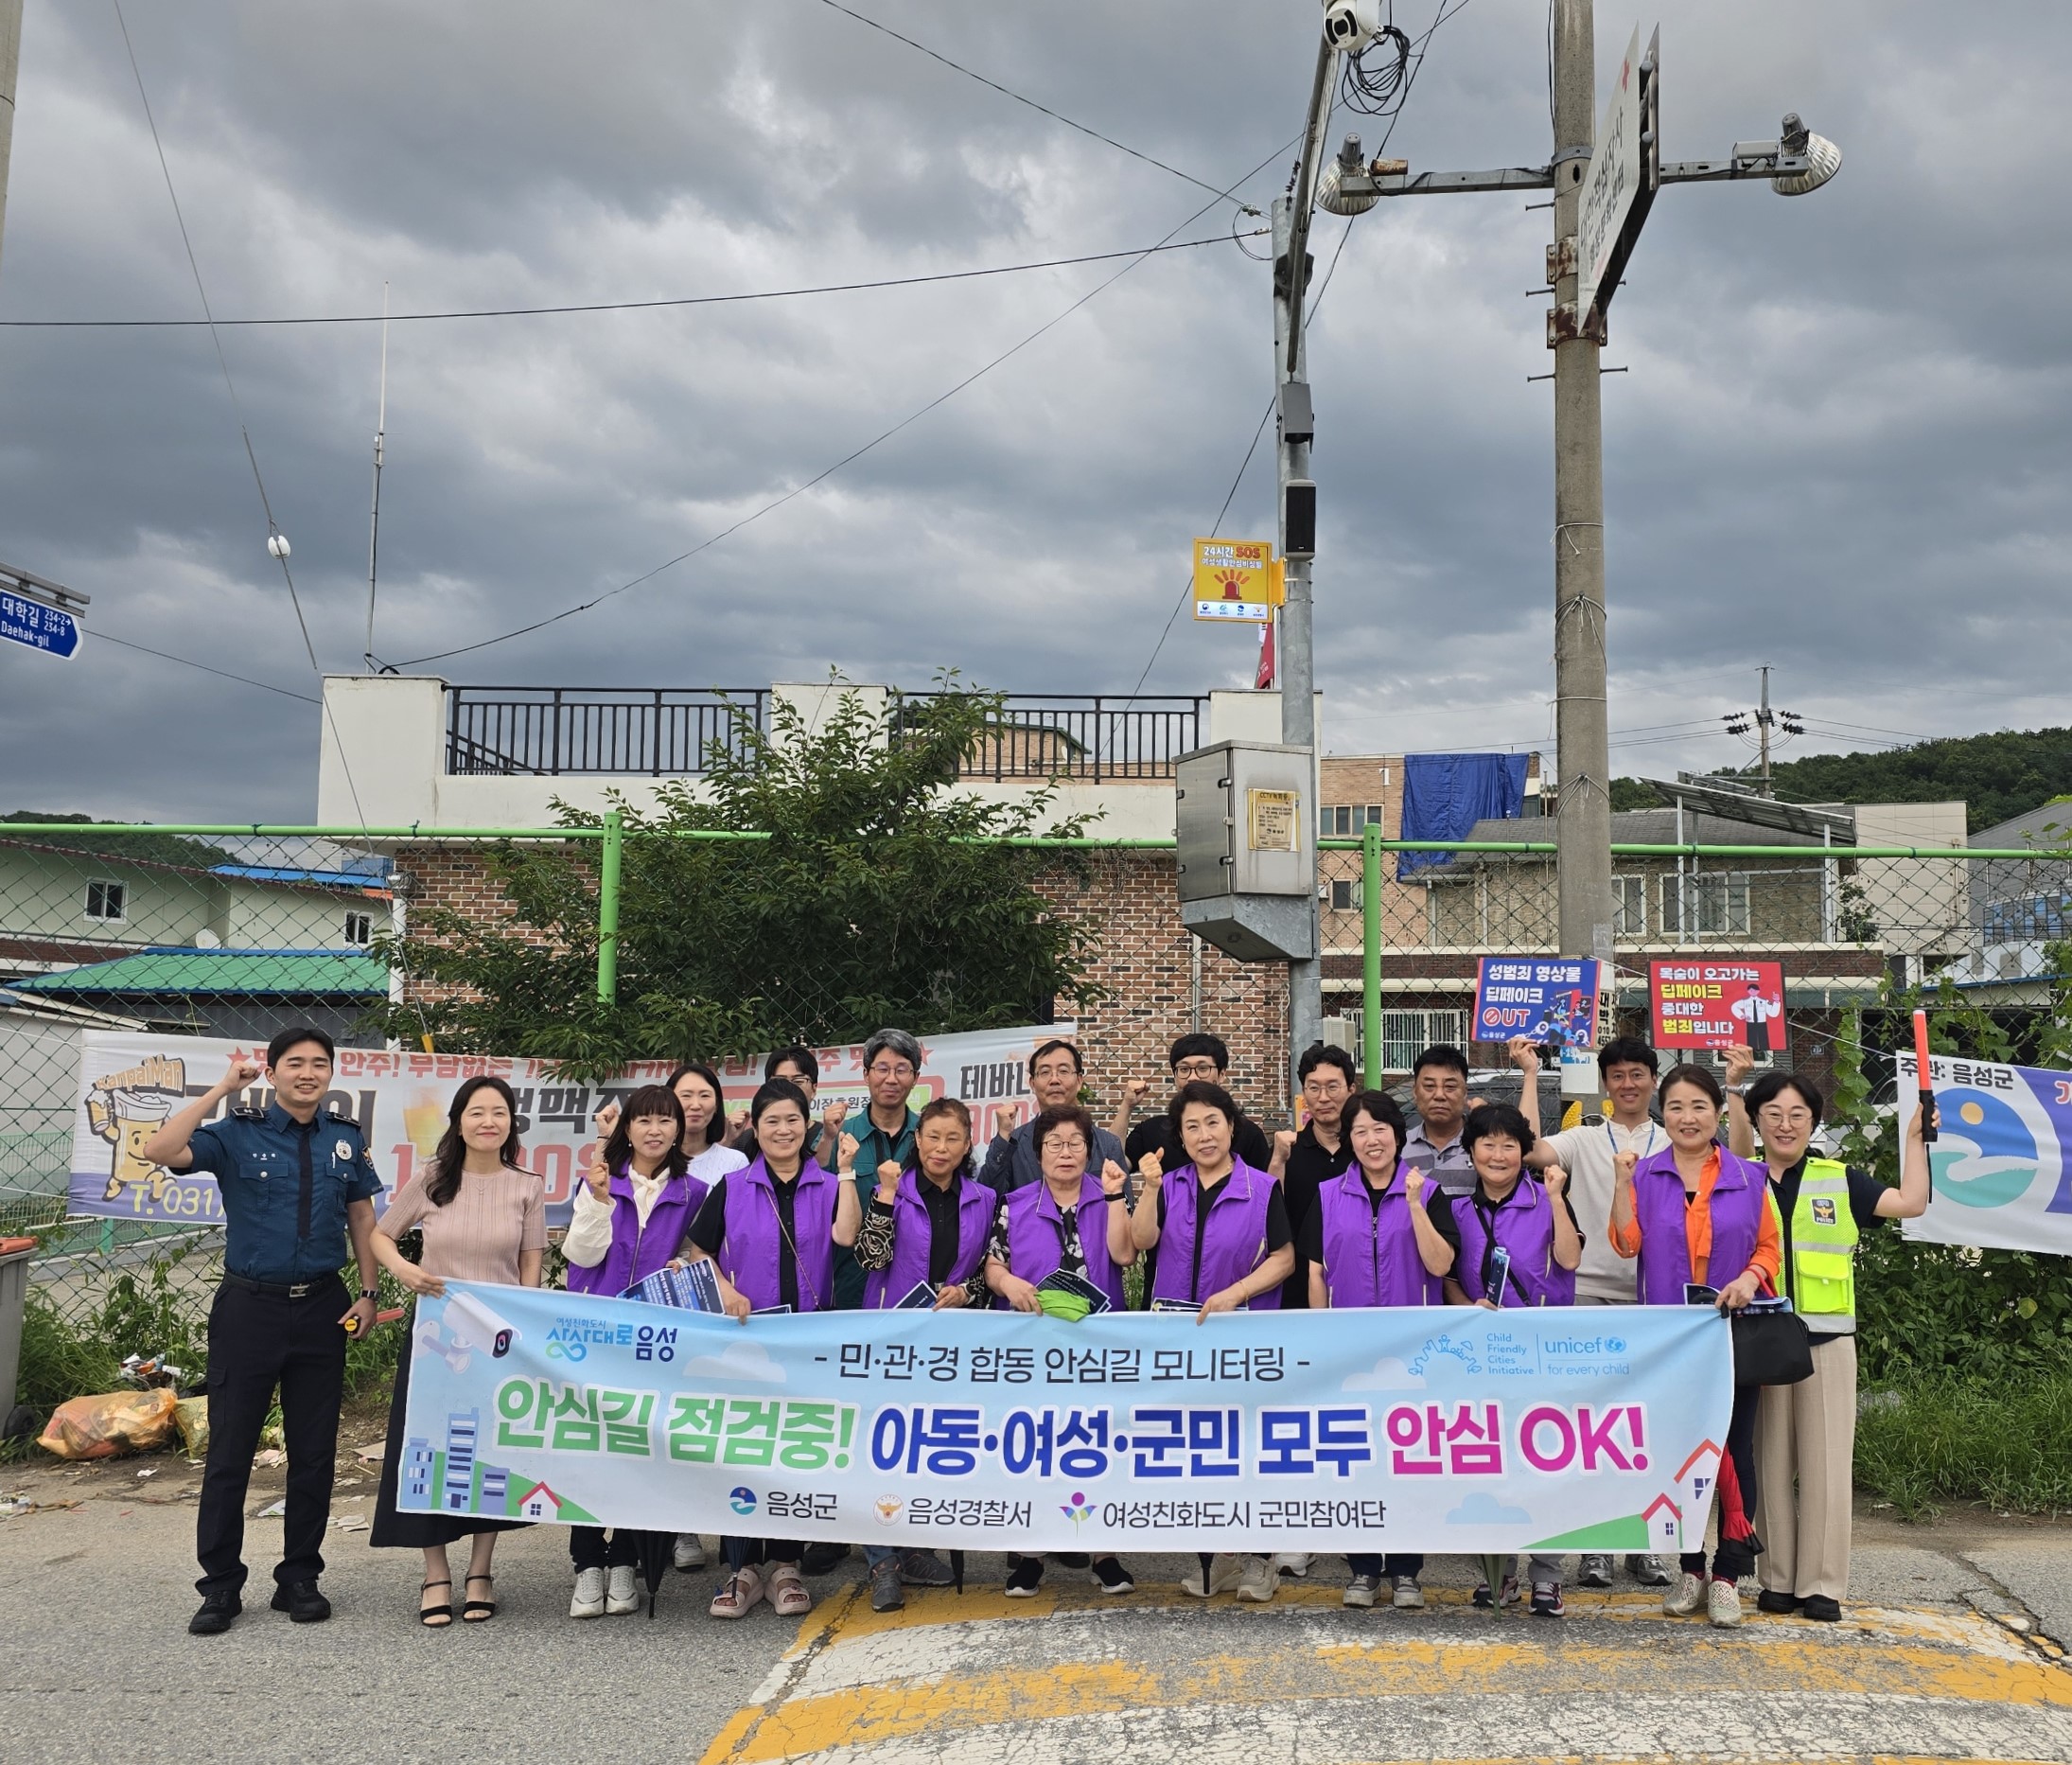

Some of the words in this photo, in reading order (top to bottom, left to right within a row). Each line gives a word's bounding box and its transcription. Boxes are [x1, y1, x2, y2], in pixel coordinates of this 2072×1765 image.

[1581, 106, 1624, 250] 대한적십자사
[1203, 546, 1234, 558] 24시간
[1236, 546, 1260, 558] SOS
[2, 597, 40, 628] 대학길
[44, 609, 65, 626] 234-2
[1, 620, 50, 647] Daehak-gil
[44, 621, 65, 636] 234-8
[1489, 964, 1532, 980] 성범죄
[1536, 965, 1581, 982] 영상물
[1659, 967, 1700, 980] 목숨이
[1704, 967, 1760, 981] 오고가는
[1485, 986, 1543, 1003] 딥페이크
[1660, 984, 1723, 999] 딥페이크
[1661, 1002, 1704, 1015] 중대한
[1662, 1019, 1734, 1034] 범죄입니다
[95, 1054, 184, 1092] KanpaiMan
[341, 1051, 400, 1077] 안주!
[408, 1055, 514, 1079] 부담없는
[1953, 1063, 2013, 1090] 음성군
[556, 1316, 606, 1330] 여성친화도시
[636, 1326, 677, 1363] 음성
[1486, 1333, 1512, 1342] Child
[1545, 1337, 1602, 1353] unicef
[1487, 1344, 1527, 1355] Friendly
[971, 1347, 1034, 1383] 합동
[1045, 1347, 1141, 1384] 안심길
[1151, 1347, 1285, 1383] 모니터링
[1488, 1355, 1516, 1364] Cities
[1488, 1366, 1534, 1375] Initiative
[1548, 1364, 1563, 1375] for
[1567, 1366, 1599, 1377] every
[1603, 1364, 1630, 1375] child
[496, 1379, 656, 1457] 안심길
[668, 1397, 856, 1471] 점검중!
[1258, 1408, 1372, 1477] 모두
[1386, 1404, 1503, 1474] 안심
[1519, 1405, 1649, 1472] OK!
[766, 1491, 838, 1521] 음성군
[907, 1498, 1032, 1528] 음성경찰서
[1103, 1501, 1251, 1529] 여성친화도시
[1259, 1500, 1387, 1529] 군민참여단
